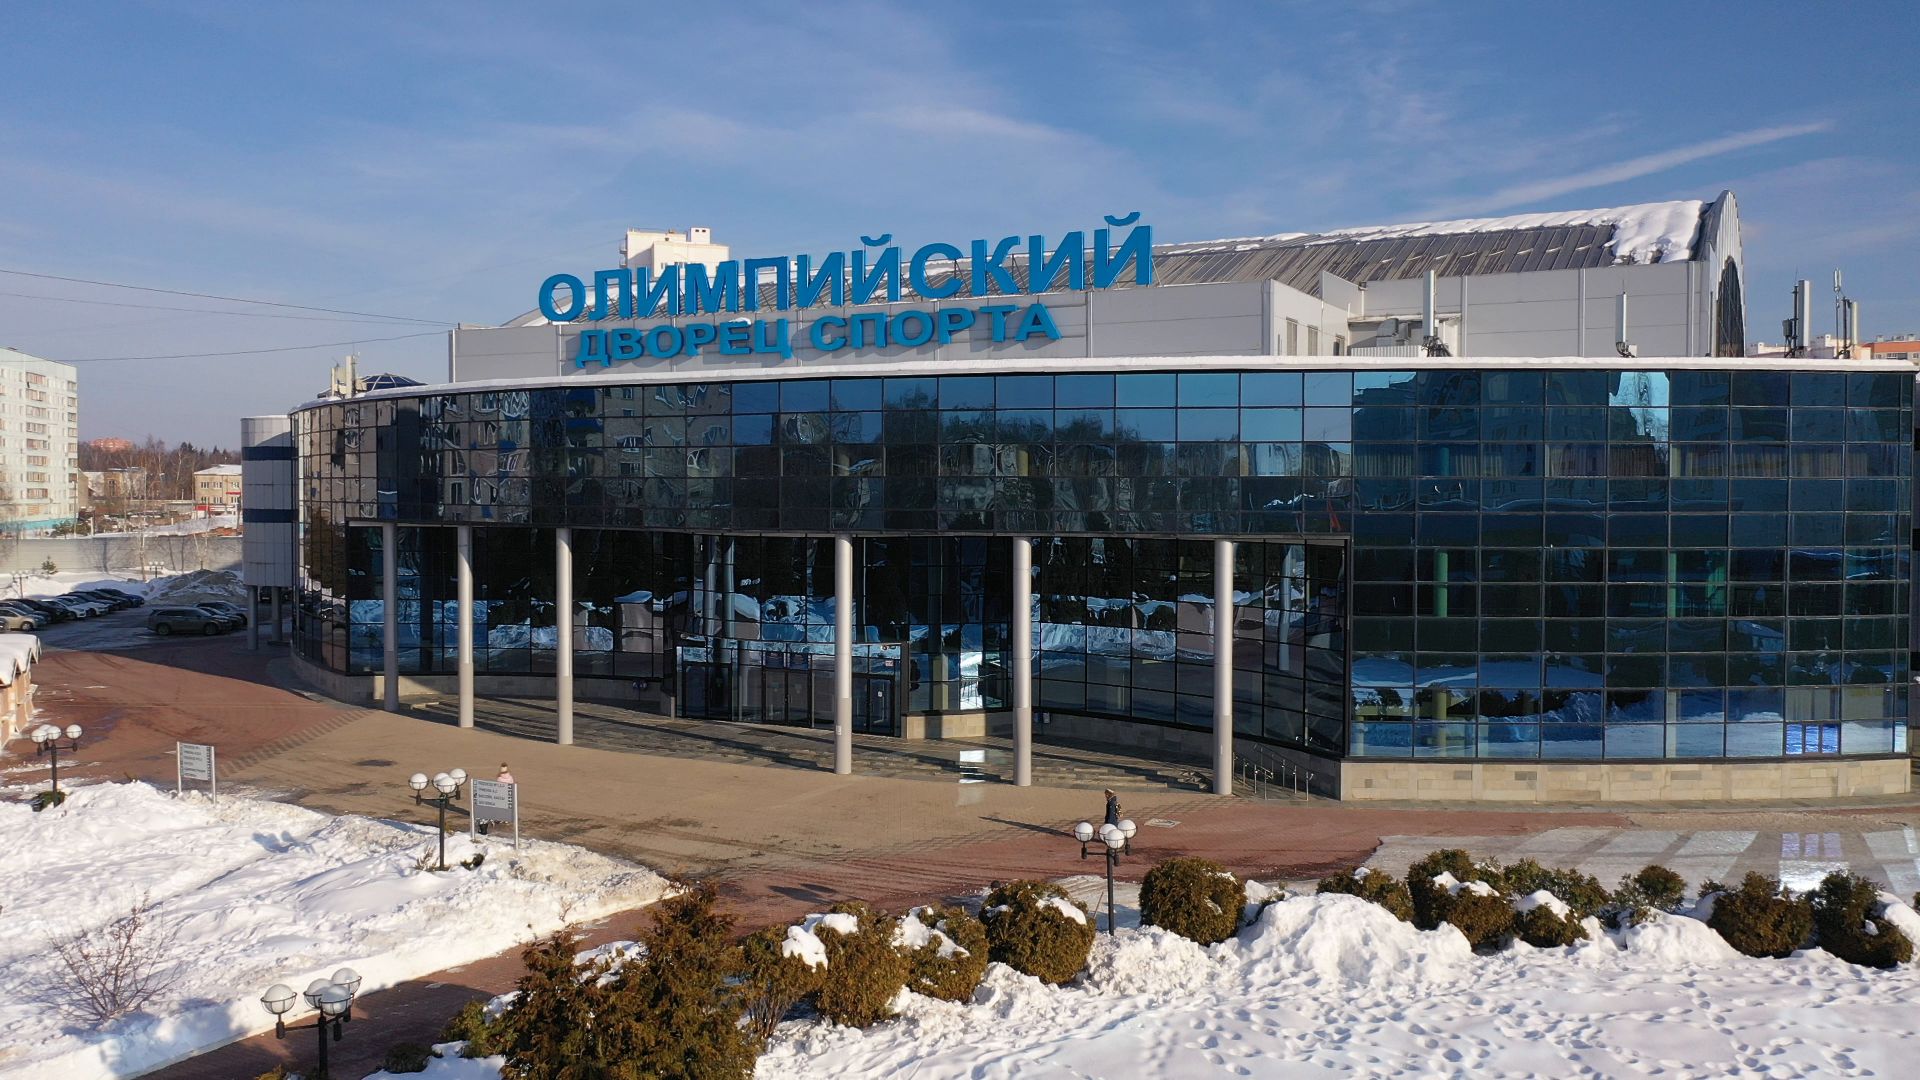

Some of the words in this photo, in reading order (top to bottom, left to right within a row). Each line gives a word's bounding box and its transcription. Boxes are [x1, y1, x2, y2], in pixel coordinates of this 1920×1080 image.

[538, 211, 1153, 323] ОЛИМПИЙСКИЙ
[575, 318, 793, 369] ДВОРЕЦ
[809, 303, 1062, 352] СПОРТА
